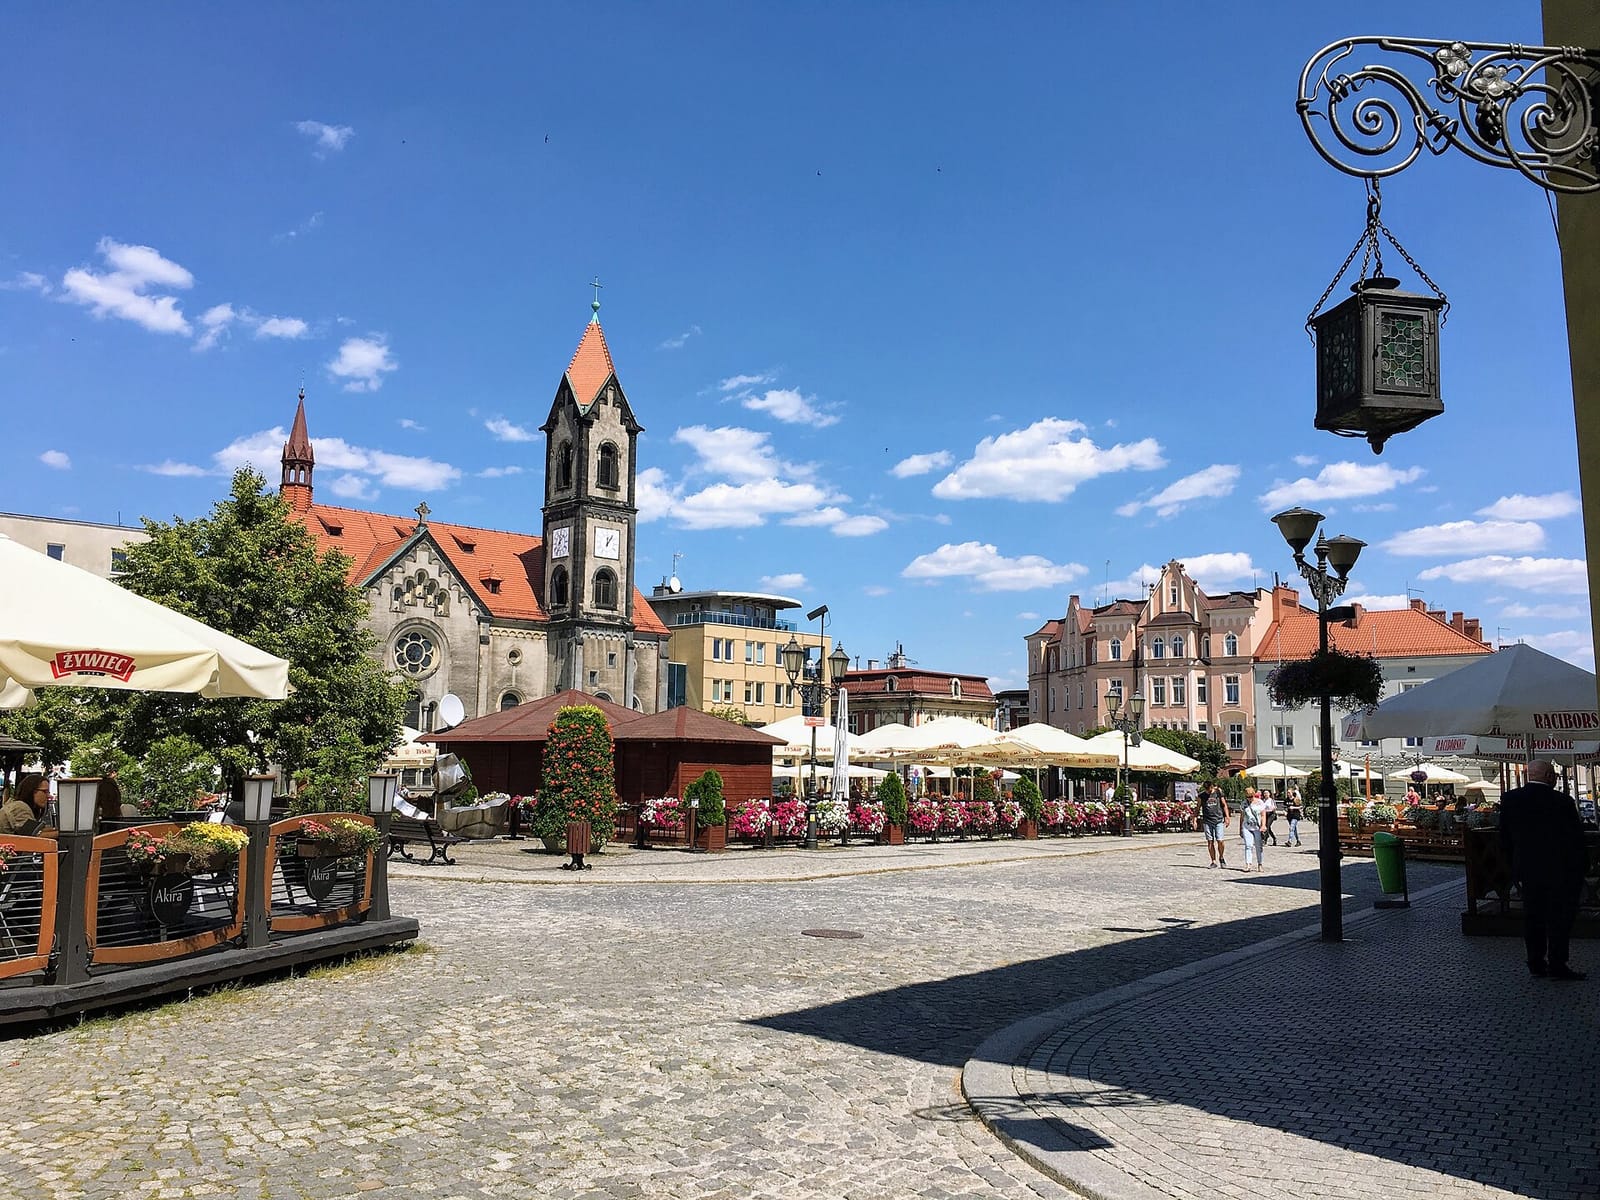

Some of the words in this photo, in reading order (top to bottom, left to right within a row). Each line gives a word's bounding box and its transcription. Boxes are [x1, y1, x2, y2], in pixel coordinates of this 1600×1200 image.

[63, 652, 128, 671] ŻYWIEC
[1533, 712, 1599, 730] RACIBORS
[311, 869, 330, 881] Akira
[154, 887, 183, 904] Akira
